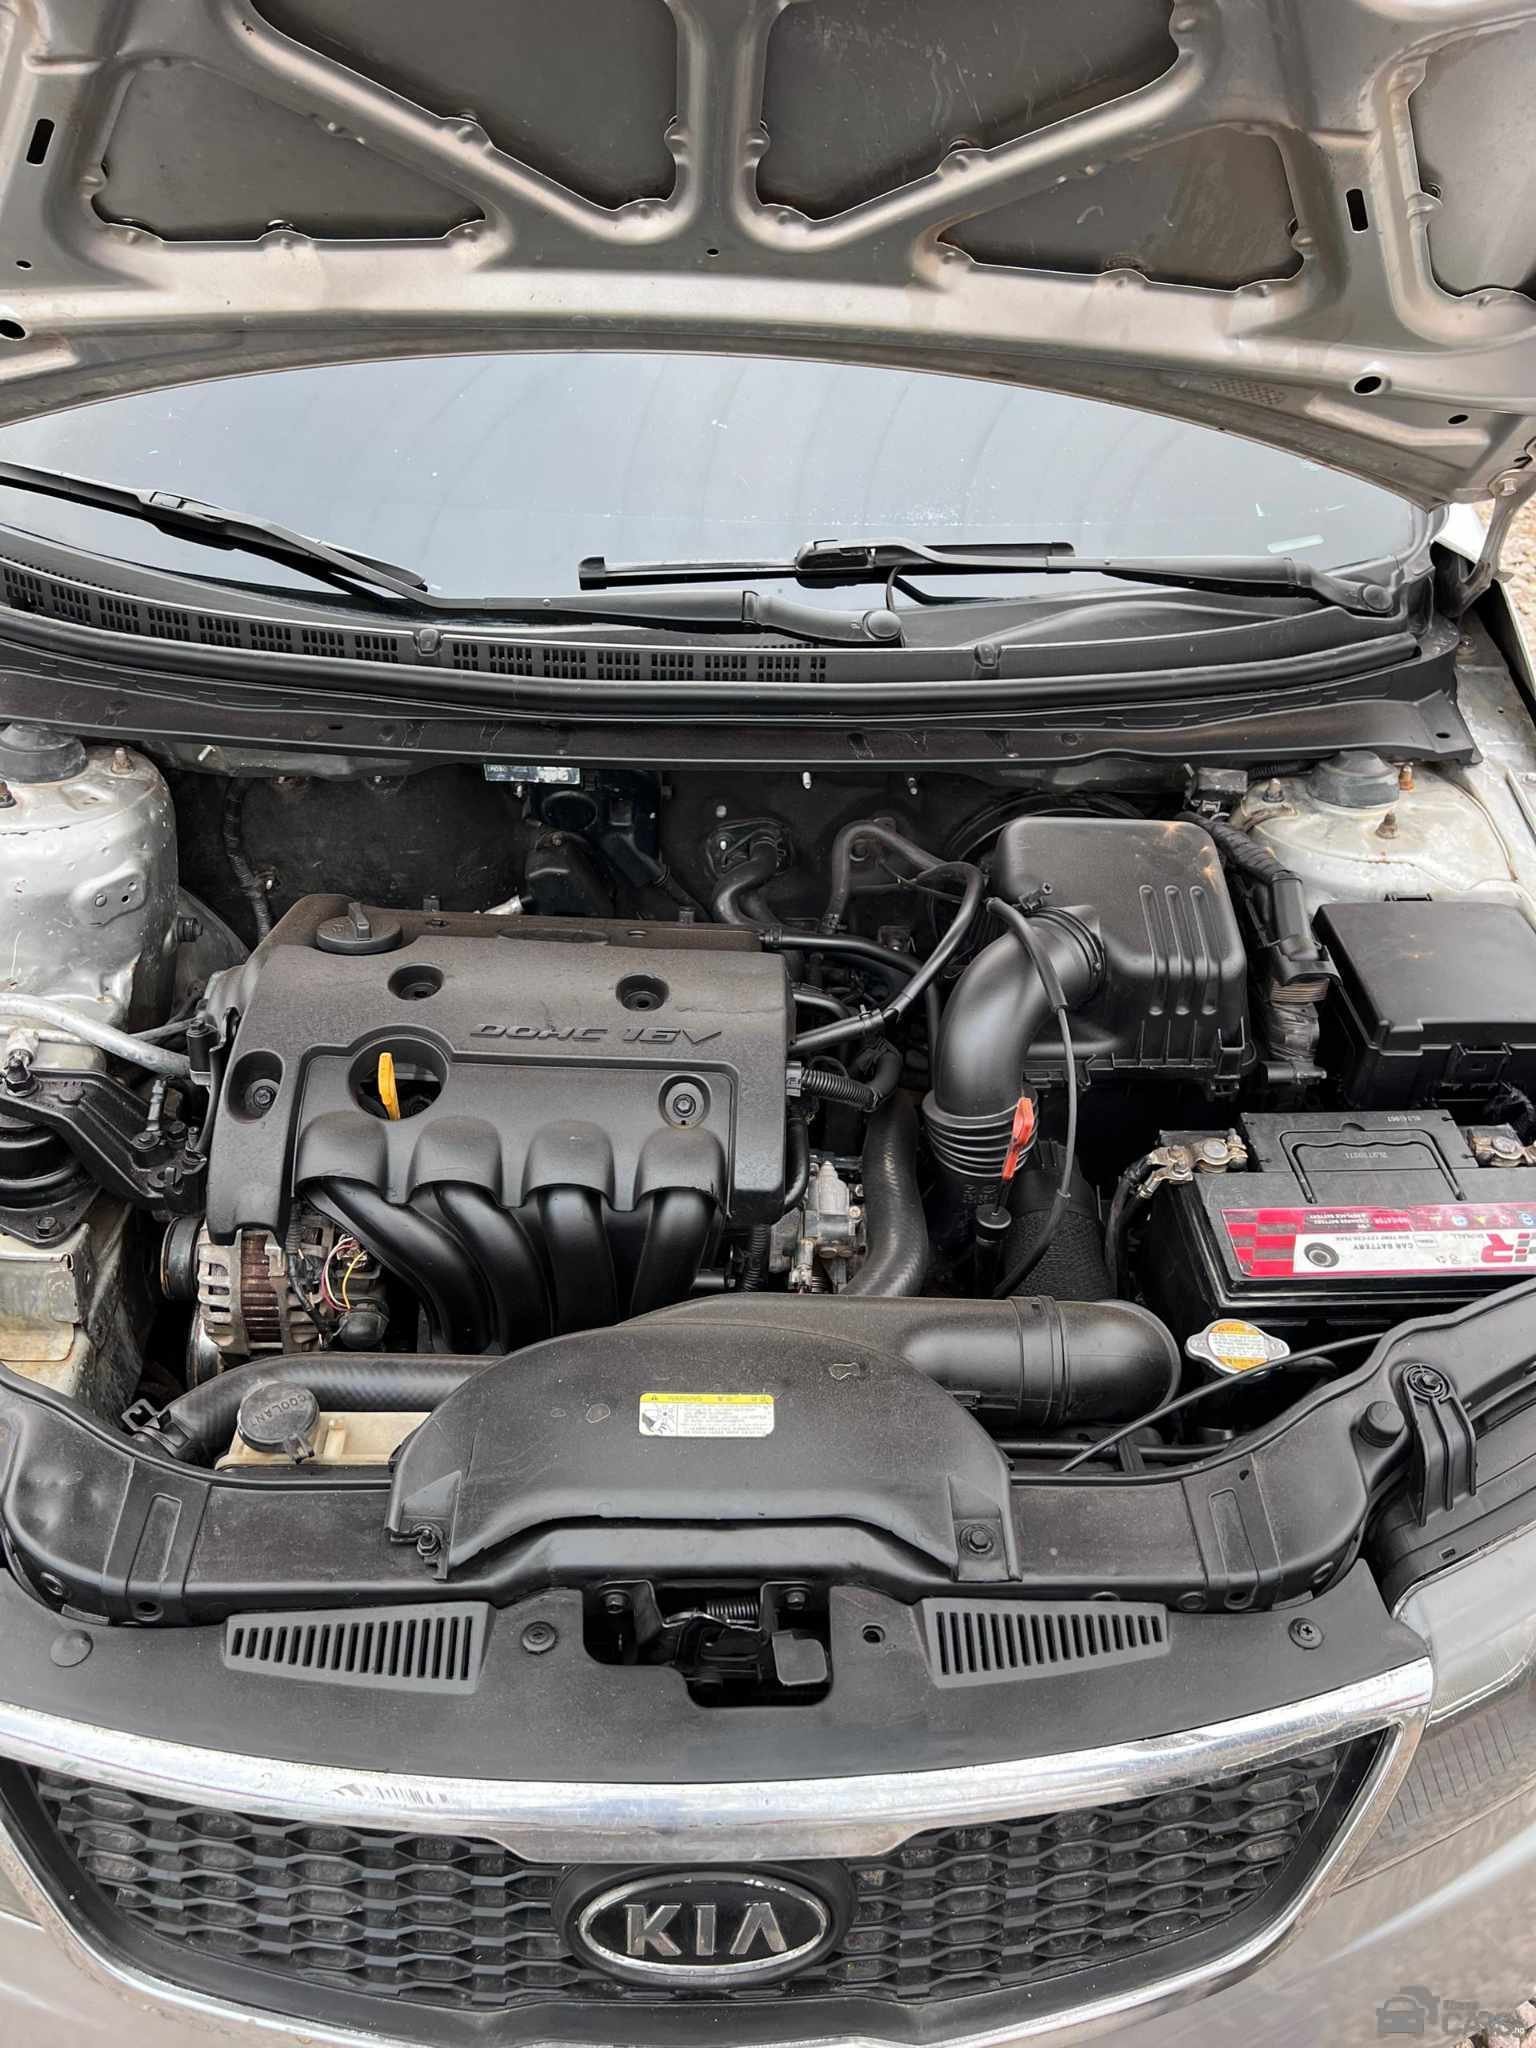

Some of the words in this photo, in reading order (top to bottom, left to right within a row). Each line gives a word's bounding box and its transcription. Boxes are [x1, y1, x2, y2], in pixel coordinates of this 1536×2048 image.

[470, 1023, 608, 1042] DOHC
[623, 1027, 723, 1045] 16V
[251, 1393, 306, 1426] COOLANT
[623, 1902, 788, 1956] KIA
